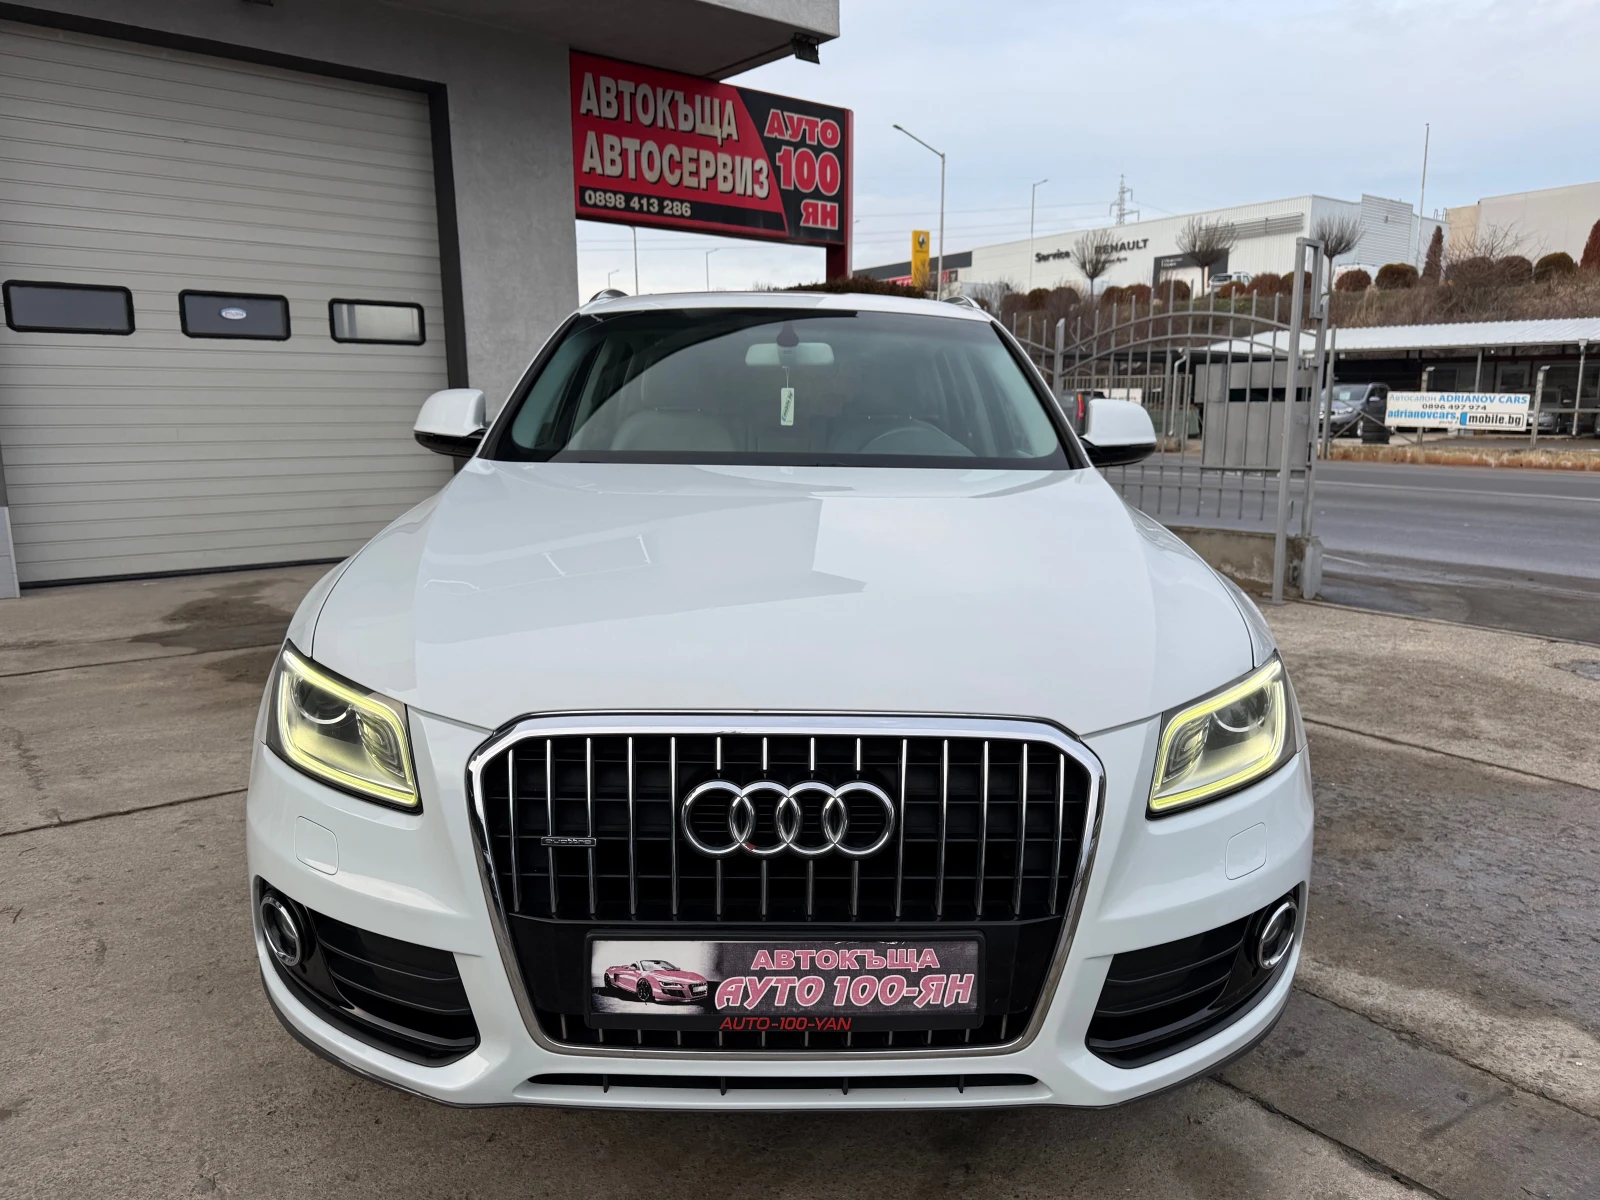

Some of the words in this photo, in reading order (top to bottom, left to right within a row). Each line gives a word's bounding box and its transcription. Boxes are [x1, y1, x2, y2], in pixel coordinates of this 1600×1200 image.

[579, 72, 739, 146] АВТОКЪЩА
[765, 109, 840, 148] АУТО
[582, 131, 770, 199] АВТОСЕРВИЗ
[776, 147, 840, 196] 100
[584, 189, 626, 209] 0898
[630, 196, 659, 213] 413
[663, 200, 692, 217] 286
[800, 200, 839, 230] ЯН
[1035, 249, 1071, 263] Service
[1389, 394, 1436, 403] Автосалон
[1438, 394, 1497, 404] ADRIANOV
[1498, 395, 1528, 405] CARS
[1468, 413, 1522, 427] mobile.bg
[750, 949, 940, 972] АВТОКЪЩА
[715, 976, 826, 1010] АУТО
[833, 974, 974, 1009] 100-ЯН
[718, 1016, 852, 1031] AUTO-100-YAN
